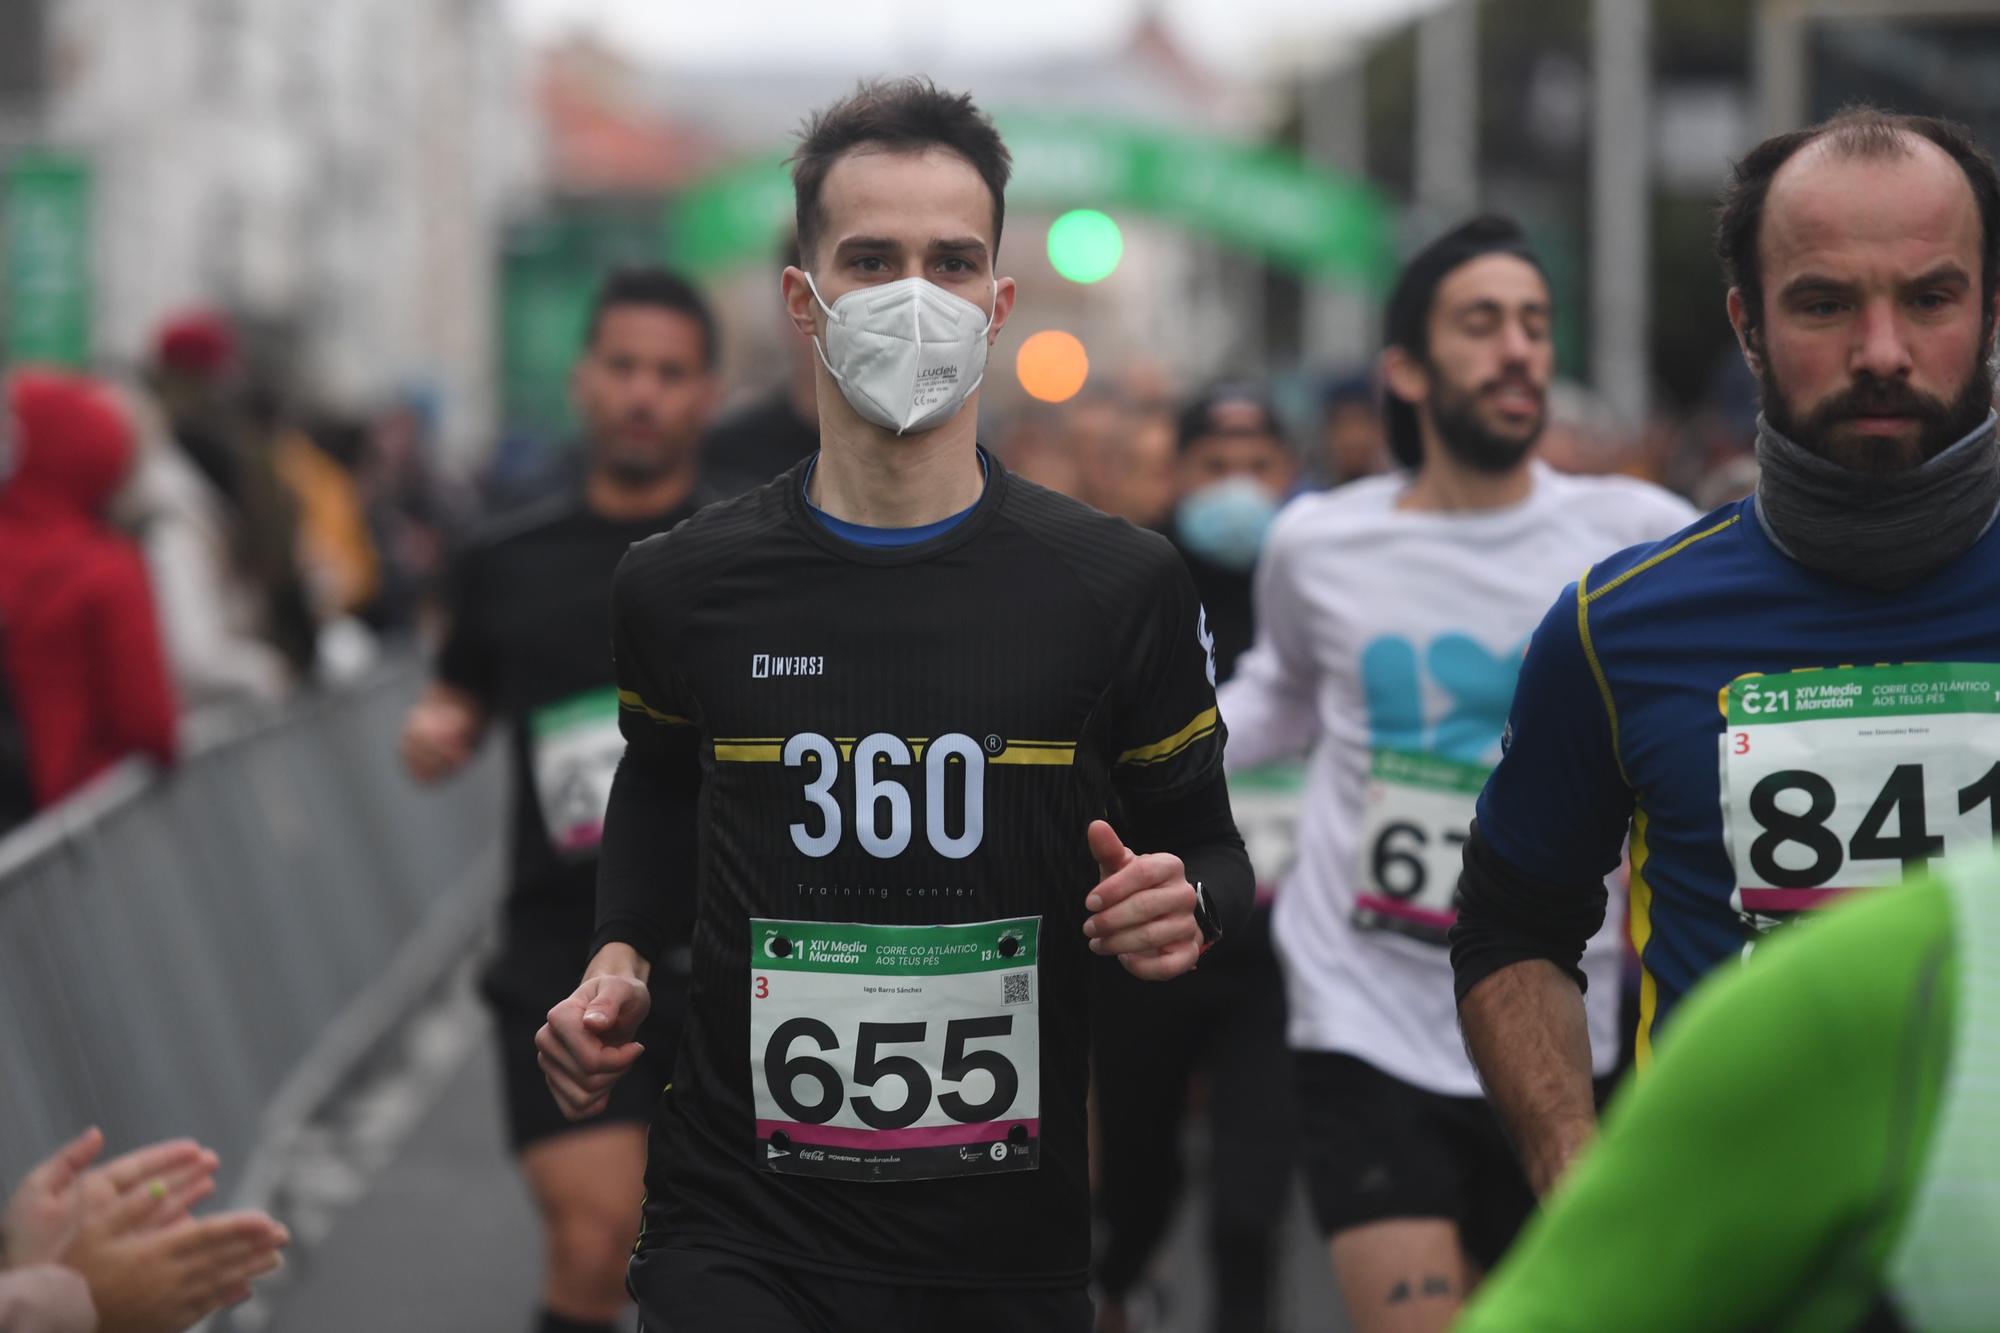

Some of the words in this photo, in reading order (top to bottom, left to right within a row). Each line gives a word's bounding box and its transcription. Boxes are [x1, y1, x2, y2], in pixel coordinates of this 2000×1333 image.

[1796, 686, 1818, 699] XIV
[1820, 683, 1862, 697] Media
[1872, 684, 1907, 695] CORRE
[1911, 682, 1928, 694] CO
[1795, 696, 1854, 711] Maratón
[1872, 696, 1895, 706] AOS
[1898, 694, 1923, 705] TEUS
[1734, 733, 1750, 755] 3
[798, 884, 888, 898] Training
[906, 886, 975, 897] center
[809, 939, 830, 951] XIV
[831, 941, 867, 953] Media
[876, 945, 907, 955] CORRE
[910, 946, 925, 955] CO
[928, 943, 978, 955] ATLÁNTICO
[809, 951, 859, 964] Maratón
[876, 956, 896, 965] AOS
[899, 957, 920, 966] TEUS
[755, 976, 769, 999] 3
[764, 1015, 1019, 1131] 655
